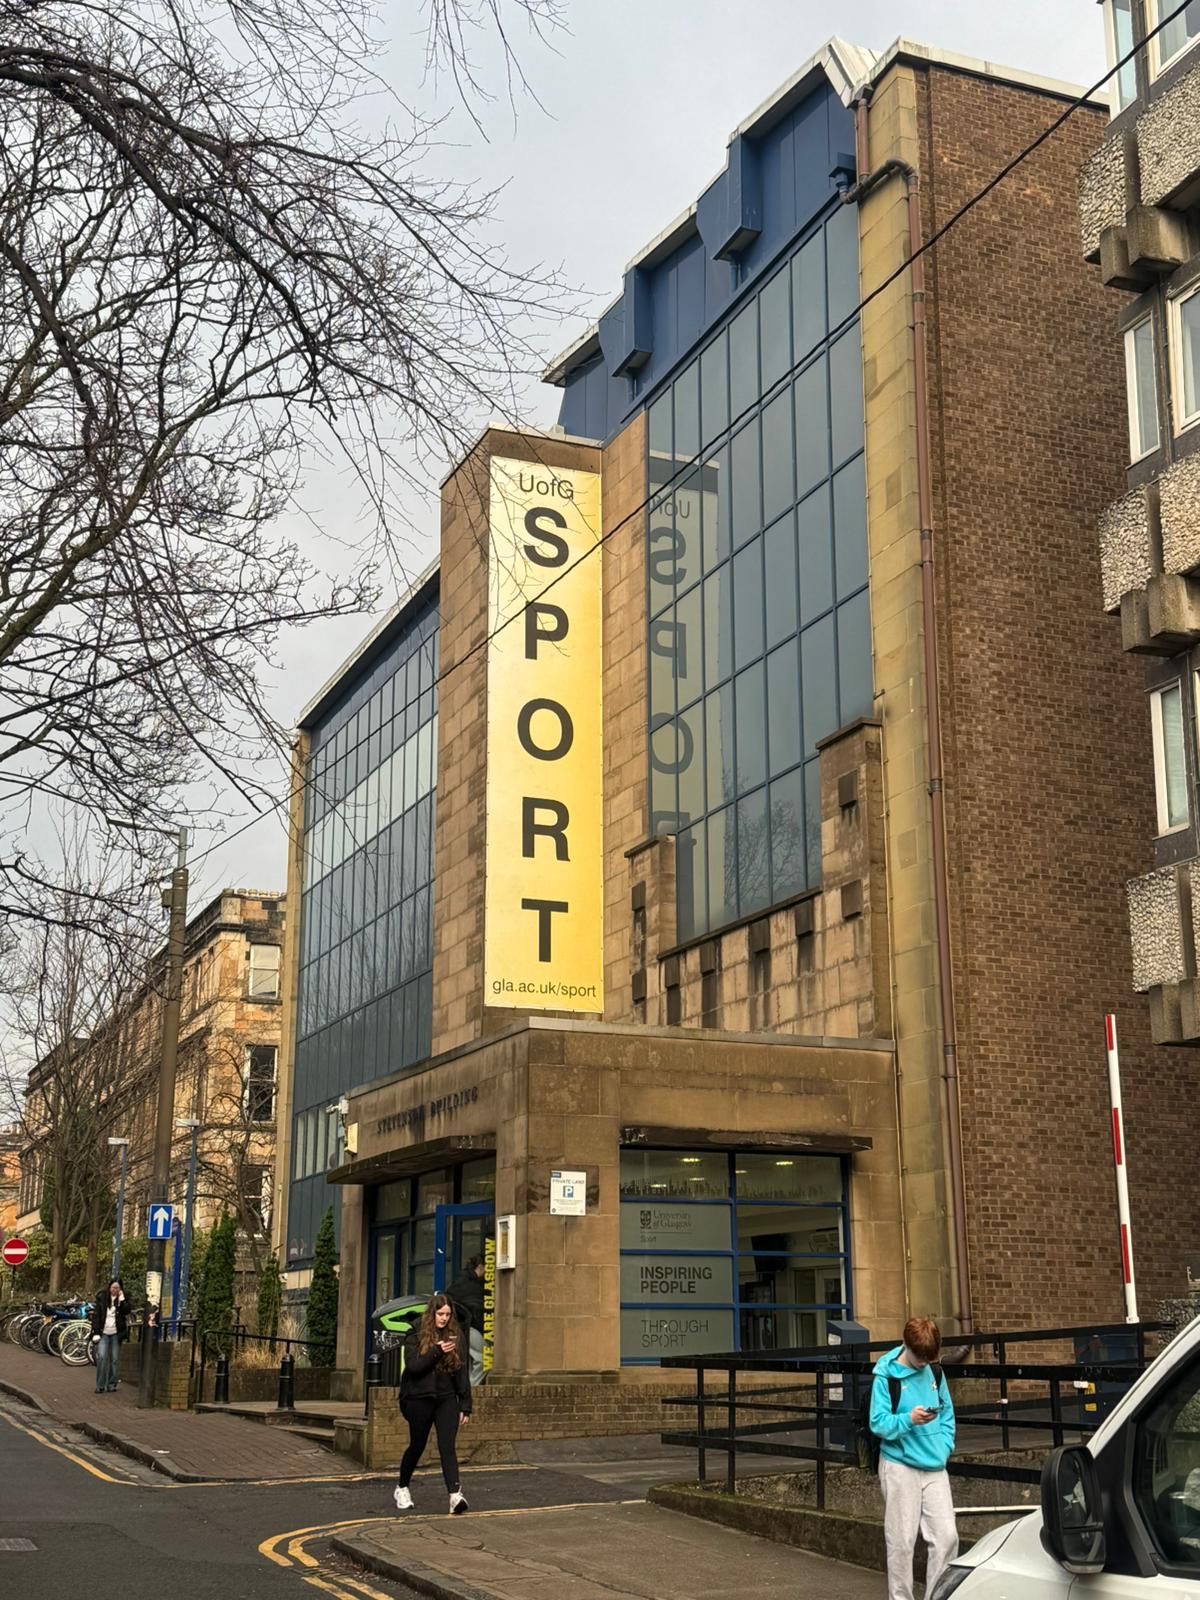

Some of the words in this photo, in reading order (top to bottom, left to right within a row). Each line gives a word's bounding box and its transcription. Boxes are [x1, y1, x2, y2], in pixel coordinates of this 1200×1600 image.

[518, 472, 575, 500] UofG
[517, 506, 574, 963] SPORT
[492, 978, 598, 998] gla.ac.uk/sport
[430, 1086, 478, 1119] BUILDING
[484, 1238, 496, 1310] GLASGOW
[640, 1266, 713, 1280] INSPIRING
[640, 1280, 697, 1294] PEOPLE
[483, 1312, 495, 1345] ARE
[640, 1319, 709, 1333] THROUGH
[641, 1334, 687, 1348] SPORT
[482, 1345, 494, 1372] WE
